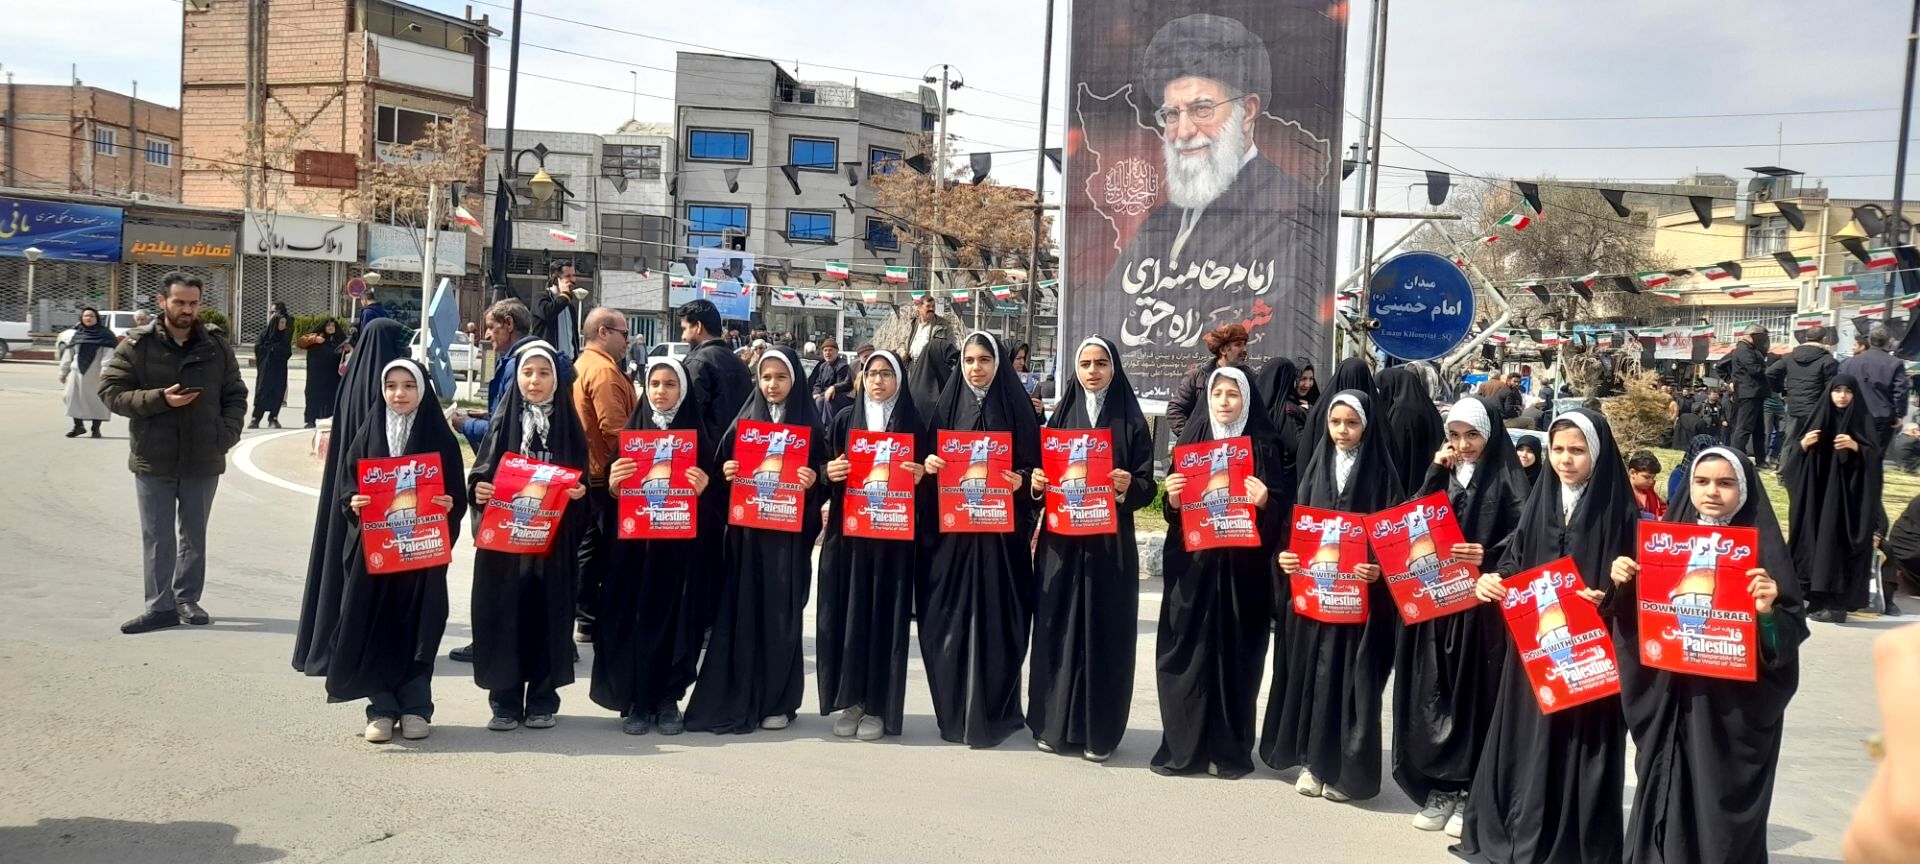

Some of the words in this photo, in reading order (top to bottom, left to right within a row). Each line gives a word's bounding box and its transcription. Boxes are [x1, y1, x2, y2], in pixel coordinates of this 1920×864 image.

[182, 241, 231, 256] قماش
[1122, 257, 1160, 294] ای
[1156, 258, 1231, 290] خامنه
[1224, 259, 1275, 295] امام
[1404, 275, 1435, 290] میدان
[1375, 295, 1427, 315] خمینی
[1431, 300, 1462, 321] امام
[1120, 297, 1175, 346] حق
[1169, 308, 1203, 347] راه
[1382, 329, 1401, 337] Emam
[1141, 387, 1170, 397] اسلامی
[741, 428, 774, 444] اسرائیل
[774, 436, 782, 445] بر
[625, 438, 658, 452] اسرائیل
[661, 443, 669, 451] بر
[852, 438, 879, 453] اسرائیل
[881, 446, 887, 454] بر
[942, 439, 975, 453] اسرائیل
[977, 444, 984, 453] بر
[1044, 436, 1073, 452] اسرائیل
[1076, 443, 1082, 451] بر
[1181, 450, 1213, 468] اسرائیل
[1216, 453, 1223, 461] بر
[363, 466, 400, 483] اسرائیل
[403, 469, 411, 480] بر
[760, 479, 779, 488] WITH
[1046, 484, 1065, 493] DOWN
[1068, 487, 1085, 495] WITH
[1086, 486, 1111, 494] ISRAEL
[621, 488, 646, 496] DOWN
[648, 488, 669, 496] WITH
[669, 488, 694, 496] ISRAEL
[746, 493, 796, 504] فلسطین
[847, 488, 867, 496] DOWN
[869, 489, 886, 497] WITH
[489, 498, 515, 510] DOWN
[516, 504, 538, 514] WITH
[635, 501, 688, 515] فلسطین
[758, 502, 797, 514] Palestine
[858, 503, 906, 514] فلسطین
[955, 499, 1005, 511] فلسطین
[1058, 498, 1107, 512] فلسطین
[1184, 502, 1208, 511] DOWN
[1209, 497, 1229, 506] WITH
[650, 511, 690, 521] Palestine
[870, 511, 908, 522] Palestine
[969, 507, 1007, 518] Palestine
[1069, 508, 1110, 519] Palestine
[1200, 510, 1249, 526] فلسطین
[364, 521, 392, 530] DOWN
[393, 519, 416, 528] WITH
[417, 514, 445, 524] ISRAEL
[1214, 519, 1253, 530] Palestine
[1296, 515, 1326, 533] اسرائیل
[1373, 515, 1409, 538] اسرائیل
[1414, 515, 1420, 527] بر
[511, 527, 549, 539] Palestine
[1328, 526, 1336, 534] بر
[382, 527, 440, 549] فلسطین
[399, 537, 443, 553] Palestine
[1645, 533, 1696, 555] اسرائیل
[1699, 543, 1711, 556] بر
[1389, 569, 1416, 584] DOWN
[1419, 563, 1440, 575] WITH
[1412, 567, 1470, 598] فلسطین
[1429, 577, 1477, 600] Palestine
[1540, 582, 1548, 595] بر
[1306, 584, 1359, 596] فلسطین
[1318, 595, 1362, 606] Palestine
[1641, 601, 1678, 613] DOWN
[1678, 606, 1710, 617] WITH
[1712, 609, 1752, 622] ISRAEL
[1662, 624, 1743, 642] فلسطین
[1522, 648, 1549, 662] DOWN
[1550, 640, 1572, 653] WITH
[1572, 628, 1605, 644] ISRAEL
[1682, 636, 1746, 657] Palestine
[1545, 645, 1606, 680] فلسطین
[1561, 658, 1614, 683] Palestine
